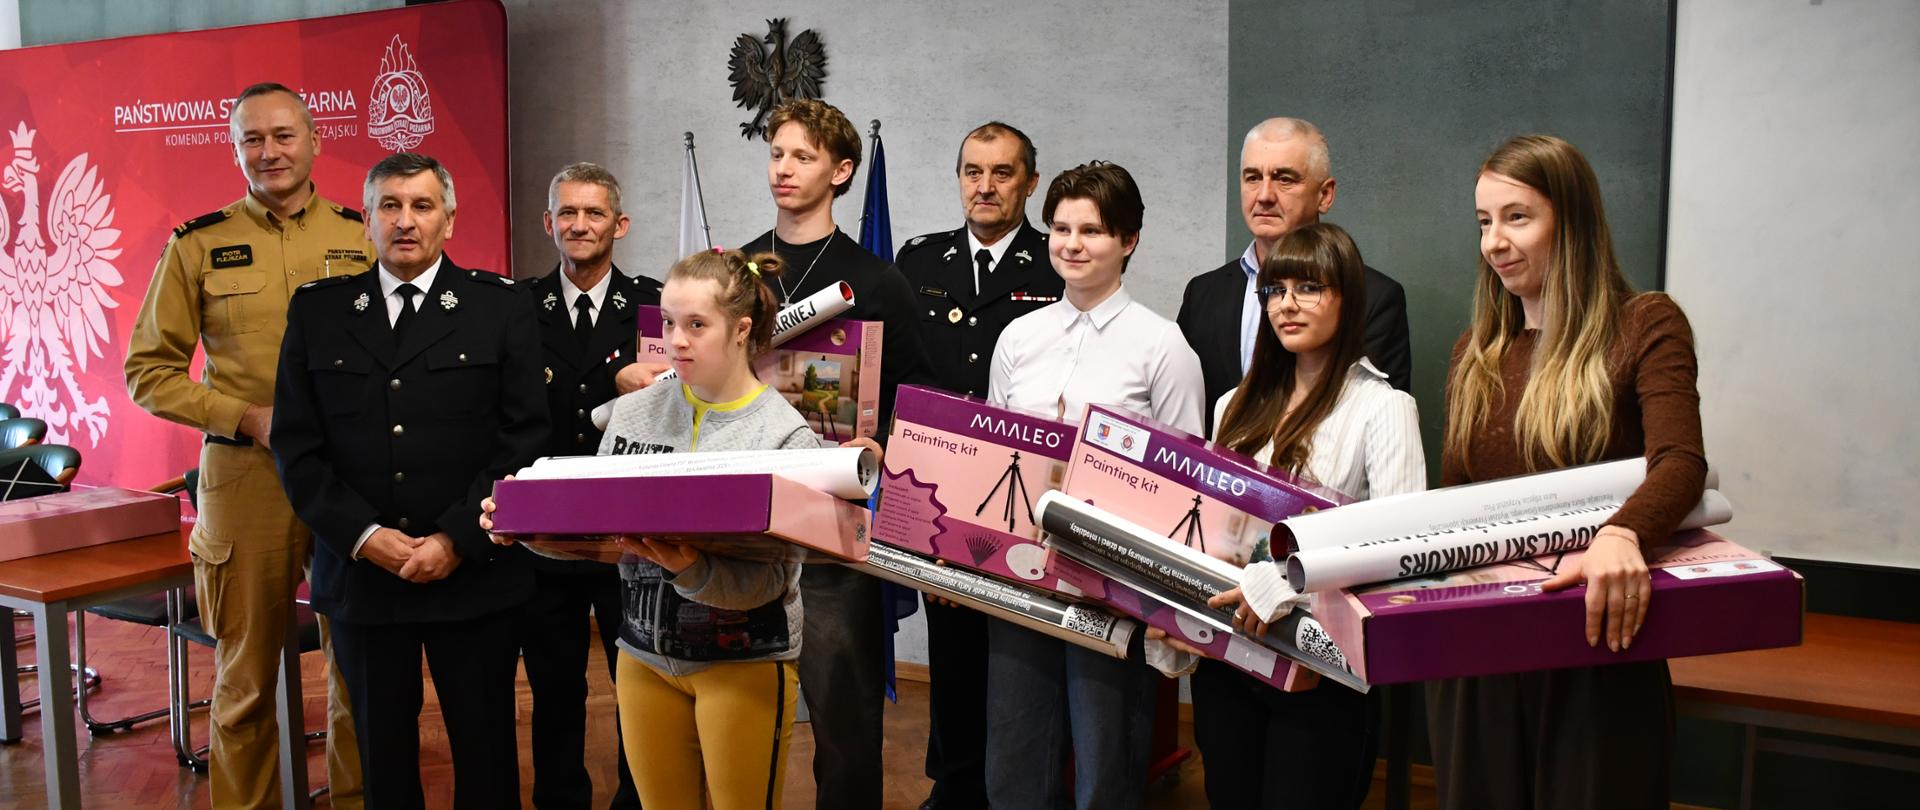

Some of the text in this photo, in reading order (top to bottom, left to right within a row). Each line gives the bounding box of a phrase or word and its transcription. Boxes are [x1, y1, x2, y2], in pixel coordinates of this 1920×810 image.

[115, 99, 216, 125] PAŃSTWOWA
[298, 88, 357, 113] ŻARNA
[165, 133, 211, 146] KOMENDA
[774, 300, 817, 335] ARNEJ
[902, 428, 979, 457] Painting kit
[1084, 453, 1160, 494] Painting kit
[1117, 544, 1127, 555] dla
[1127, 545, 1154, 567] Konkursy
[1398, 525, 1600, 577] NOPOLSKI KONKURS
